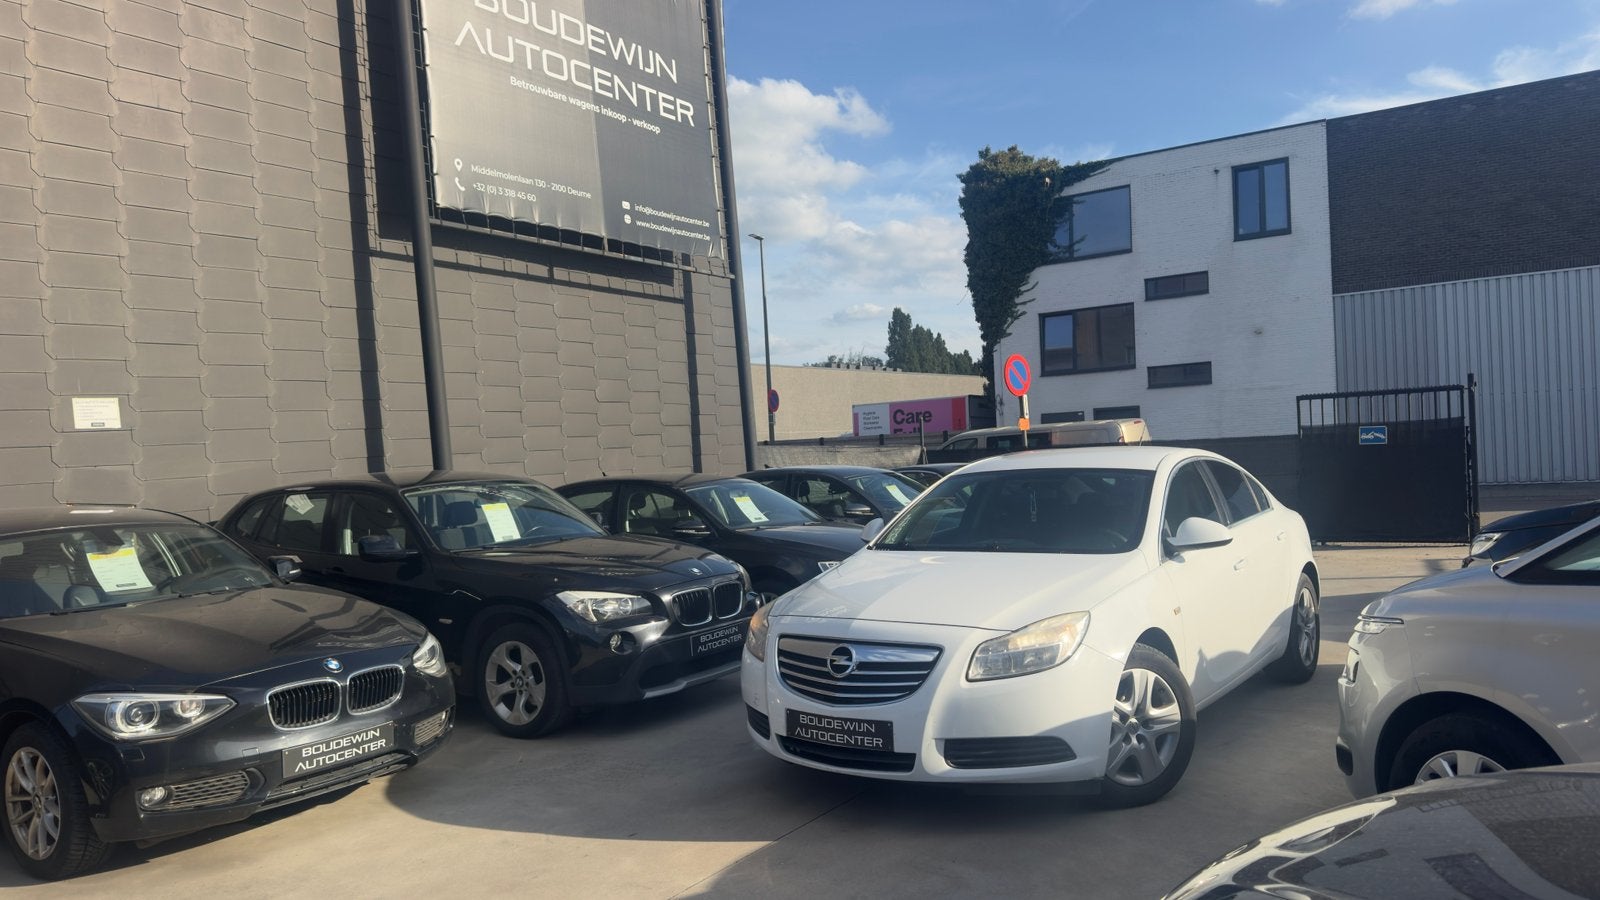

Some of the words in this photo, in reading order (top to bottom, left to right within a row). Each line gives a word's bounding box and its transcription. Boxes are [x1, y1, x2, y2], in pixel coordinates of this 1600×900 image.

[454, 20, 695, 128] AUTOCENTER
[510, 75, 567, 103] Betrouwbare
[568, 96, 600, 113] wagens
[601, 105, 627, 124] inkoop
[632, 117, 662, 135] verkoop
[471, 164, 534, 186] Middelmolenlaan
[535, 179, 546, 188] 130
[551, 182, 567, 193] 2100
[567, 186, 591, 199] Deurne
[473, 183, 485, 192] +32
[487, 184, 497, 195] (0)
[498, 186, 504, 195] 3
[505, 188, 516, 198] 318
[517, 191, 526, 200] 45
[527, 193, 537, 202] 60
[634, 203, 710, 228] info@boudewijnautocenter.be
[636, 220, 711, 241] www.boudewijnautocenter.be
[892, 409, 932, 425] Care
[697, 633, 742, 653] AUTOCENTER
[700, 625, 738, 643] BOUDEWIJN
[800, 714, 875, 733] BOUDEWIJN
[302, 728, 380, 758] BOUDEWIJN
[795, 727, 883, 748] AUTOCENTER
[294, 738, 386, 773] AUTOCENTER
